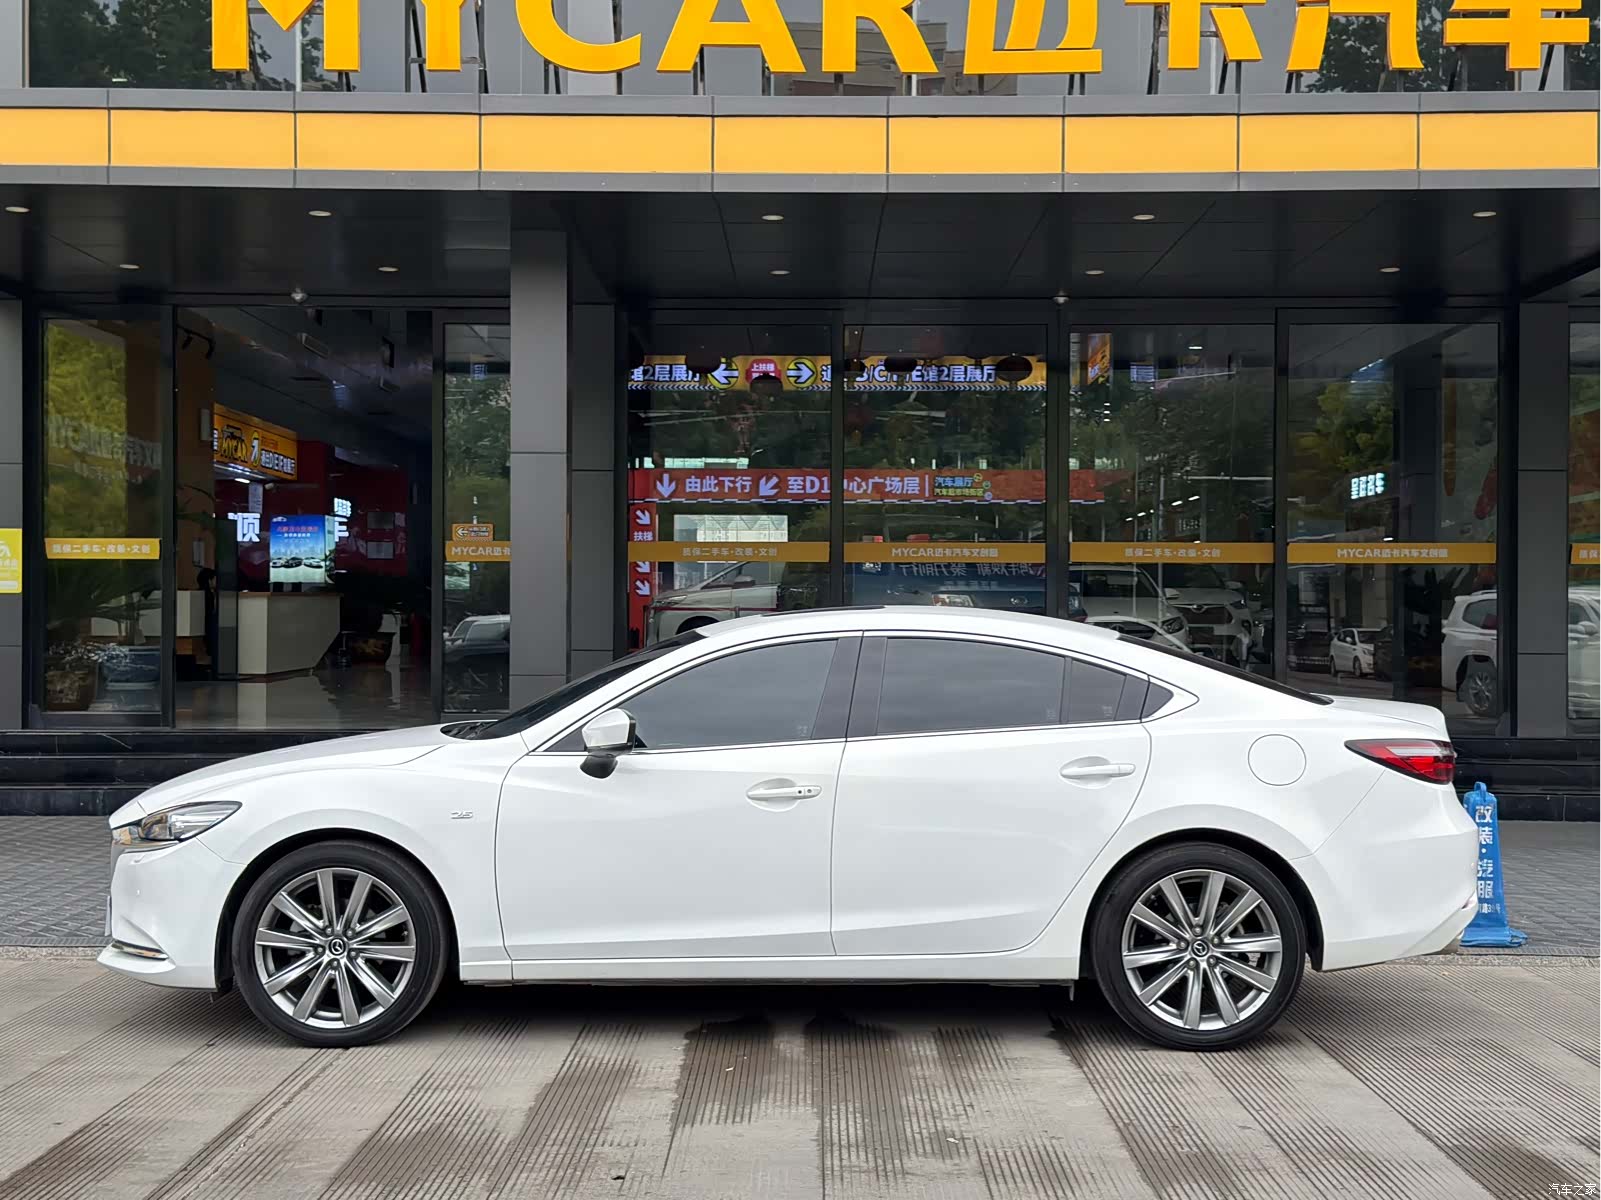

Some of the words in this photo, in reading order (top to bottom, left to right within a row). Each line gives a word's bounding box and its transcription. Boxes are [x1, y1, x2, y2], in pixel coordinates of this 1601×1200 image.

[685, 476, 752, 494] 由此下行
[786, 476, 921, 495] 至D1心广场层
[934, 476, 974, 487] 汽车展厅
[633, 531, 653, 541] 扶梯
